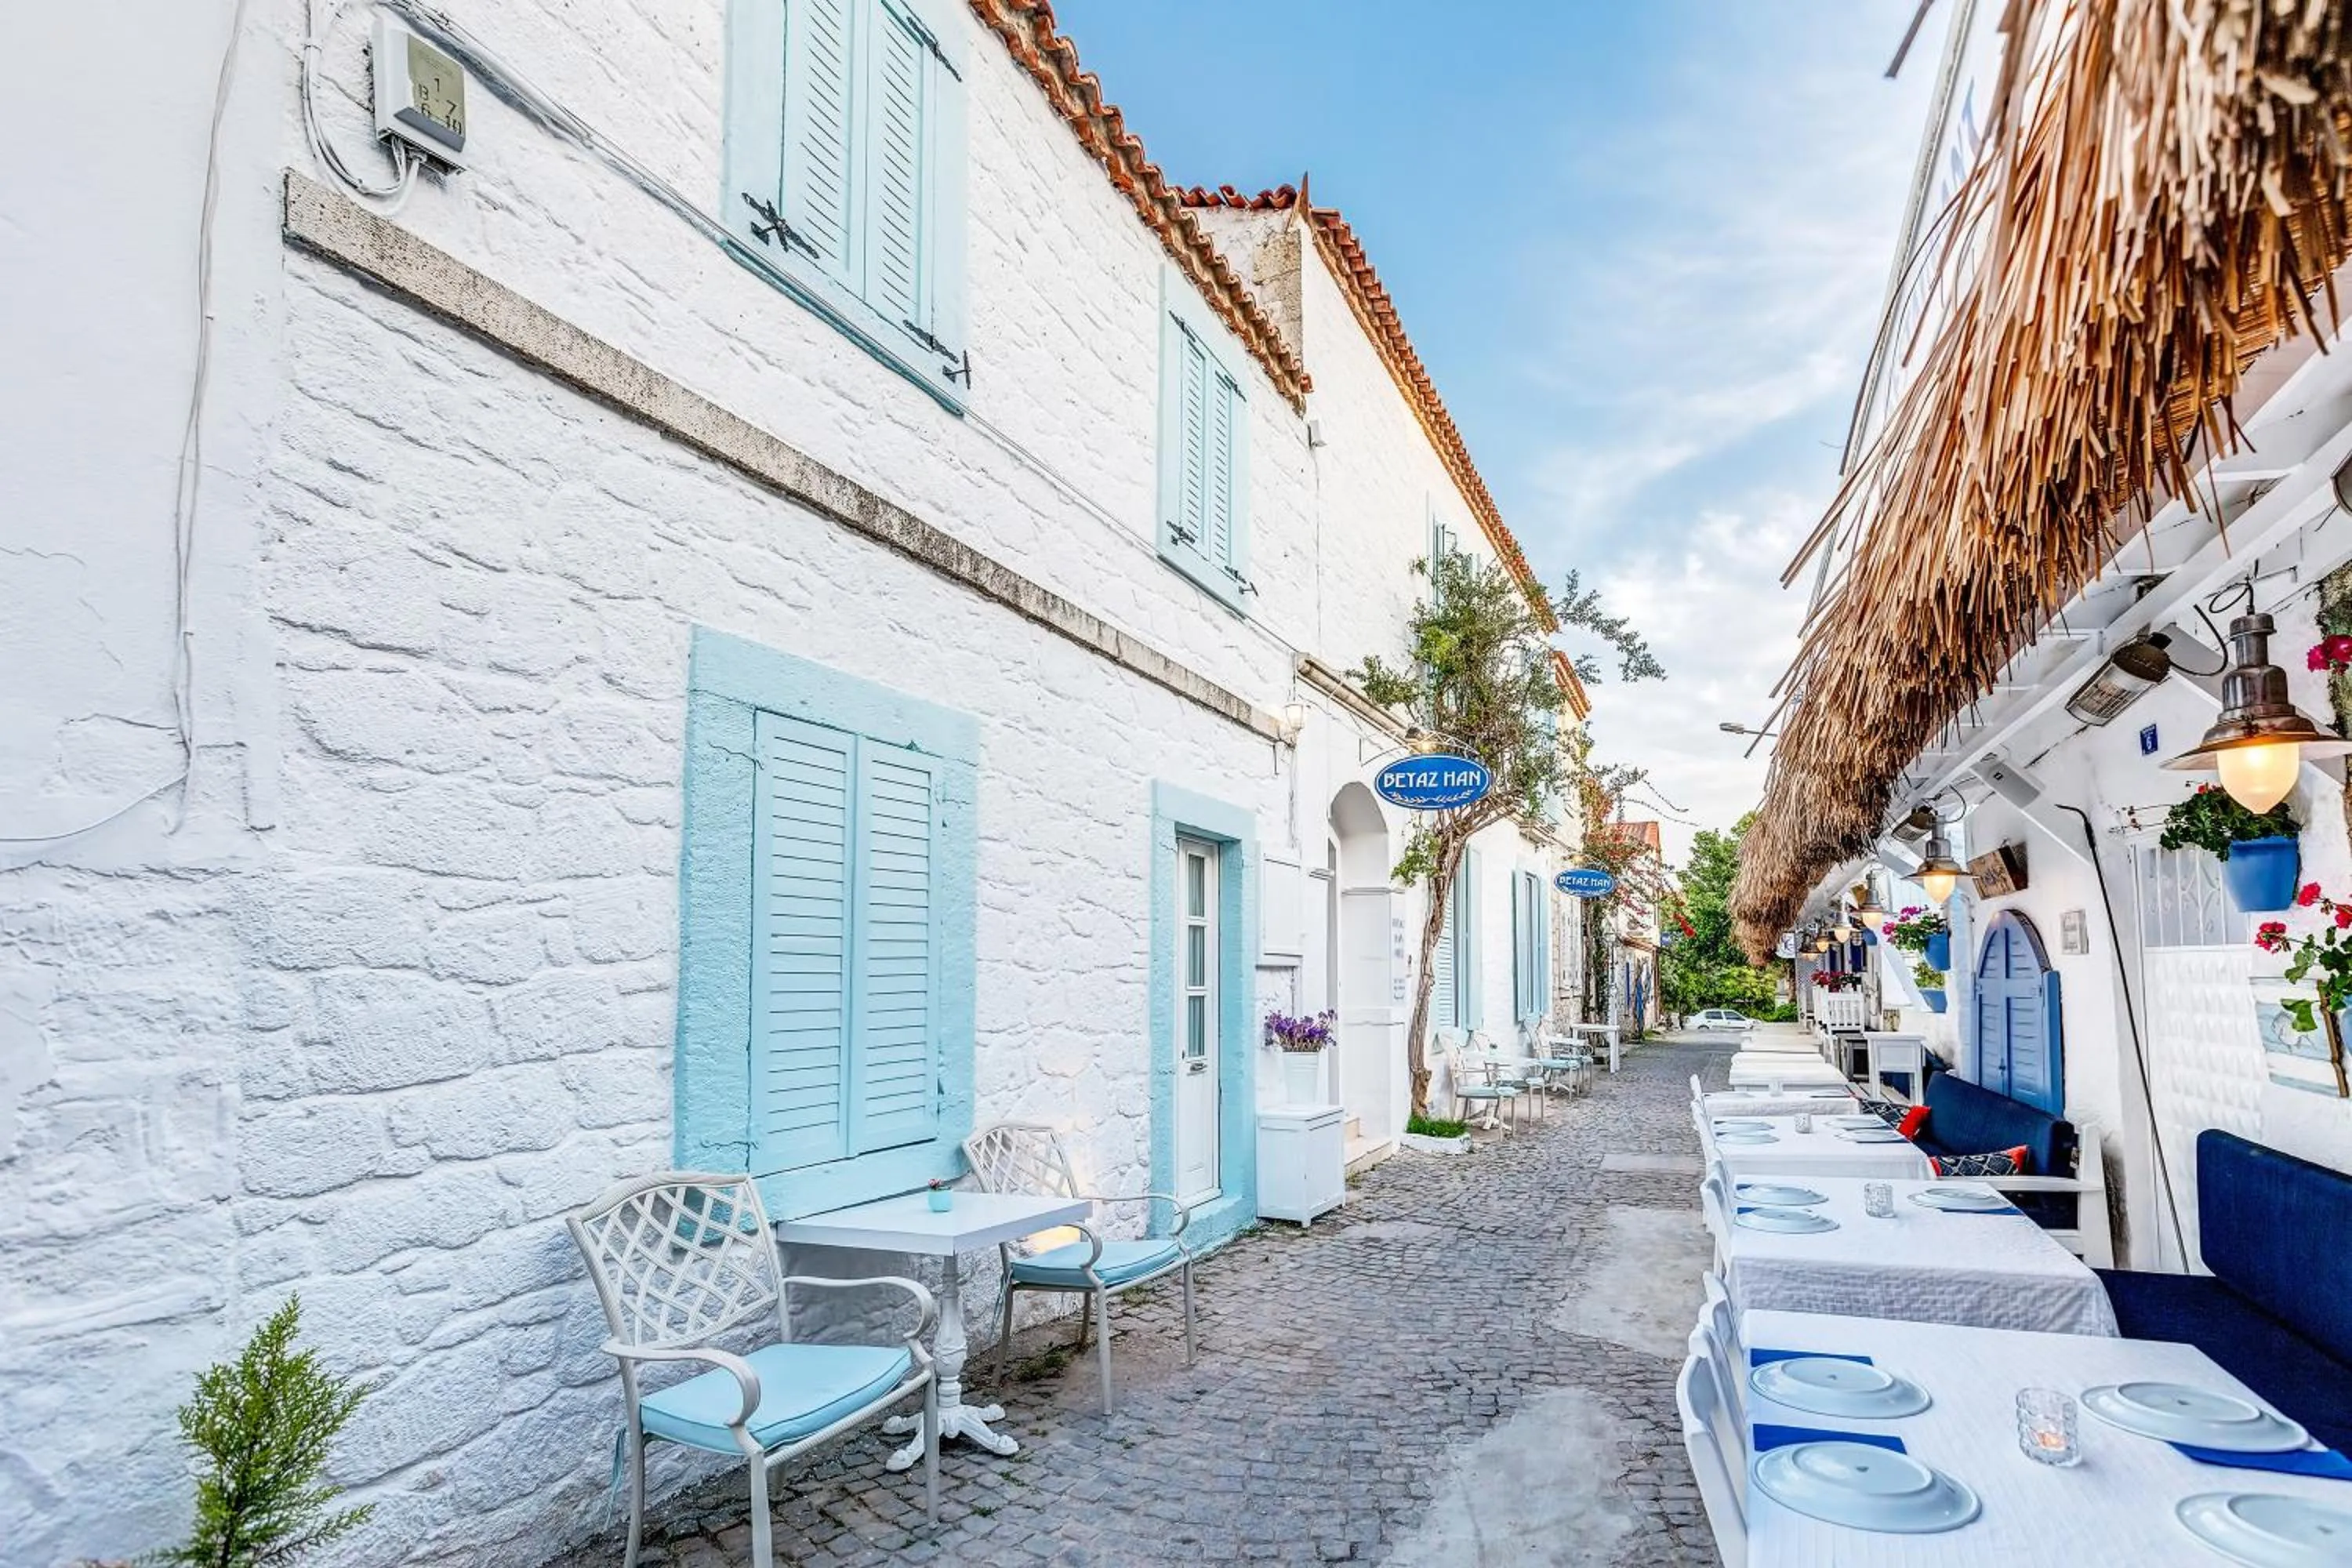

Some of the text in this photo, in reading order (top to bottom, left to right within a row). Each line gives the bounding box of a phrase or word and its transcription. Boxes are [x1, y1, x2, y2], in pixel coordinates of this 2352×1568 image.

[1383, 771, 1481, 788] BEYAZ HAN
[1591, 877, 1610, 888] HAN
